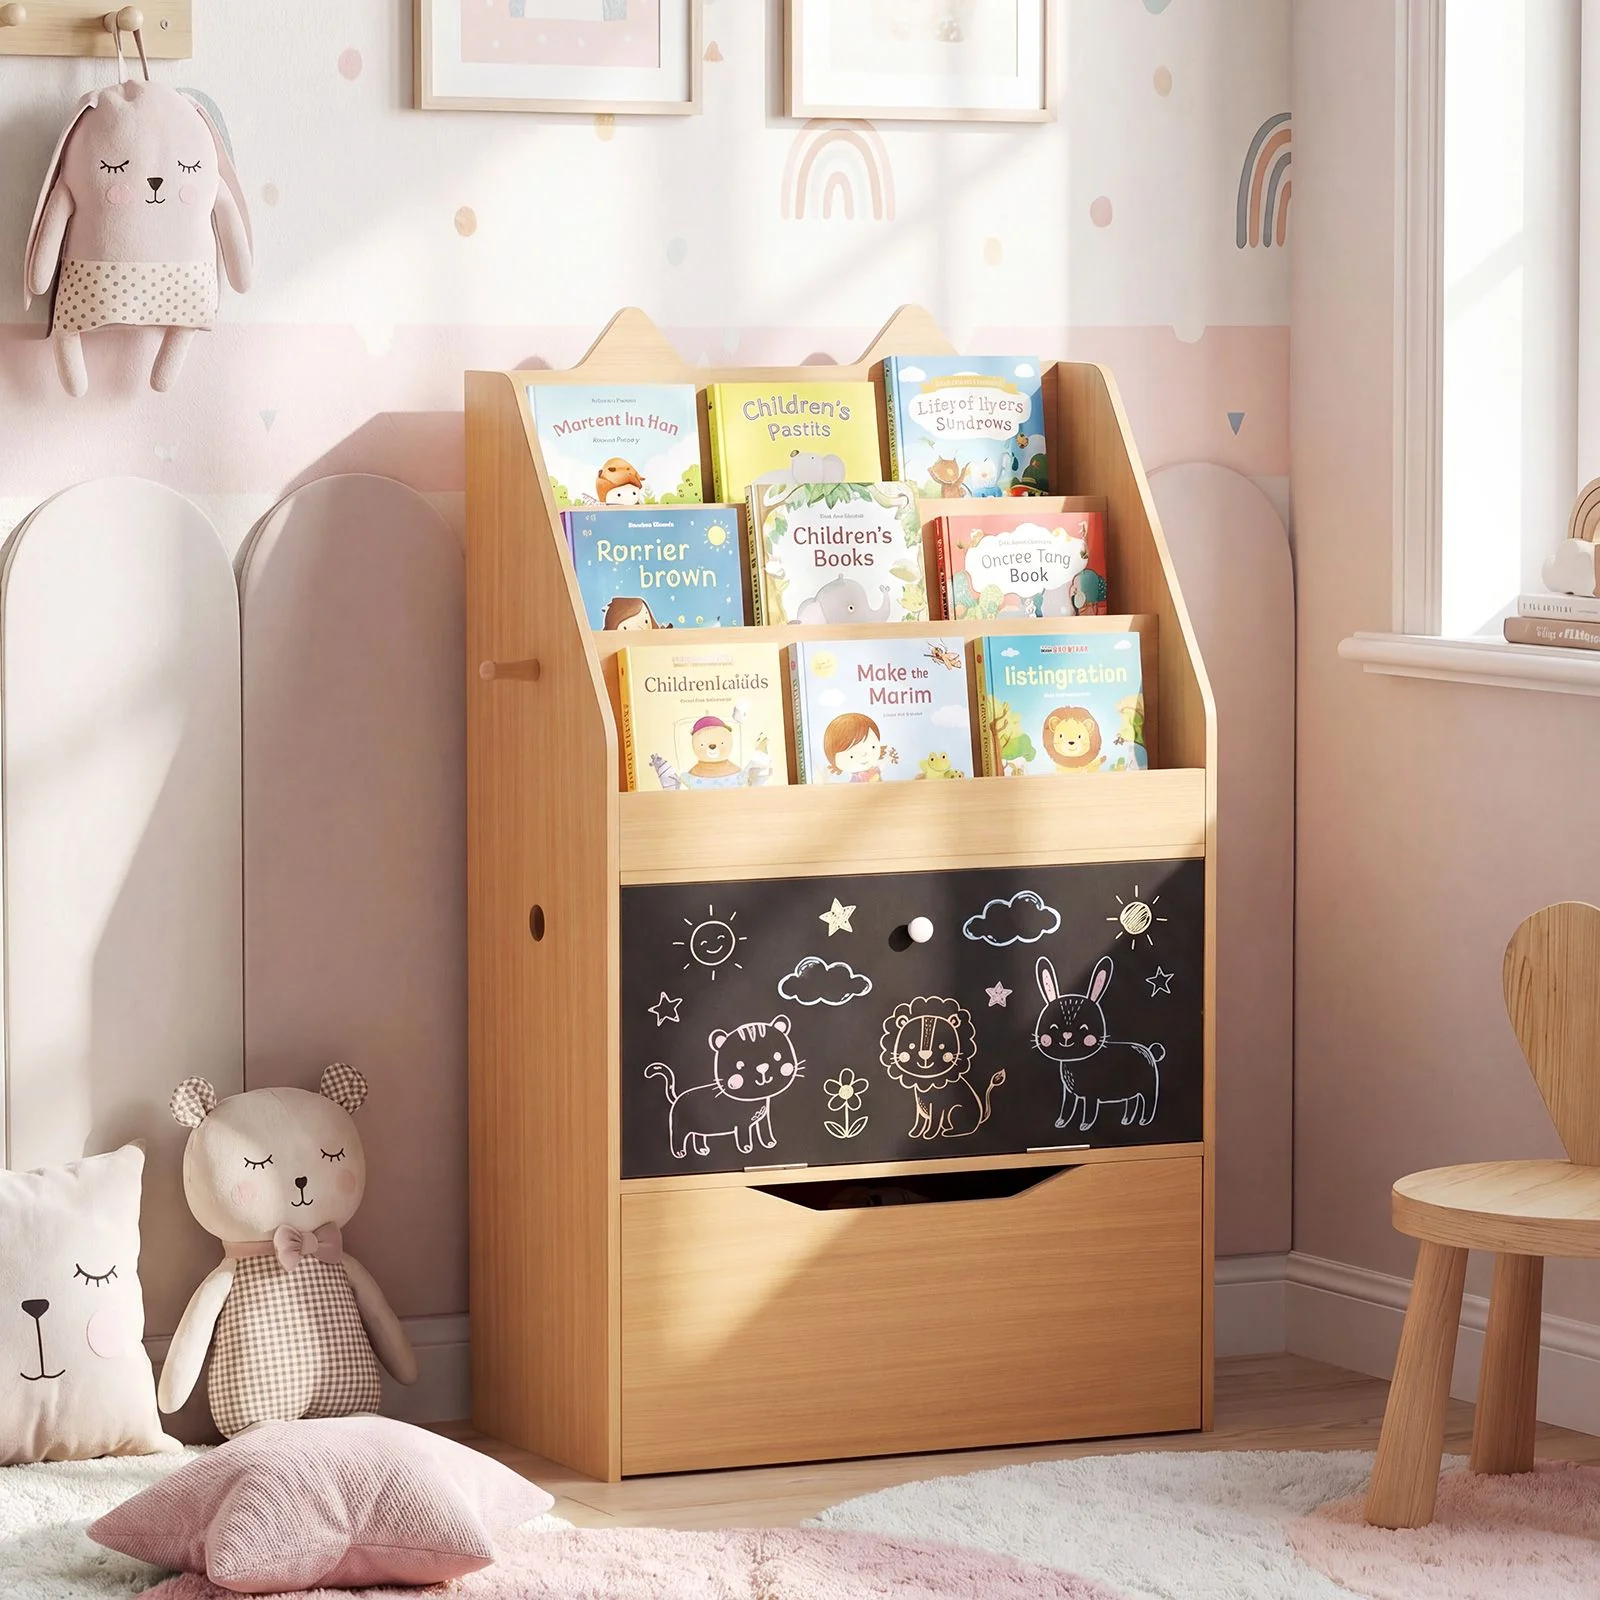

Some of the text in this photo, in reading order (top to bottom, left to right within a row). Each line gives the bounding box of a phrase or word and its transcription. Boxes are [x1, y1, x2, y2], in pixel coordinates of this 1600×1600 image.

[743, 395, 851, 421] Children's
[552, 412, 621, 437] Martent
[648, 414, 679, 436] Han
[768, 421, 831, 441] Pastits
[793, 526, 892, 545] Children's
[814, 548, 875, 567] Books
[981, 548, 1071, 569] Oncree Tang
[639, 564, 718, 588] brown
[1010, 567, 1049, 583] Book
[857, 663, 929, 682] Make the
[1005, 664, 1127, 690] listingration
[869, 687, 932, 705] Marim
